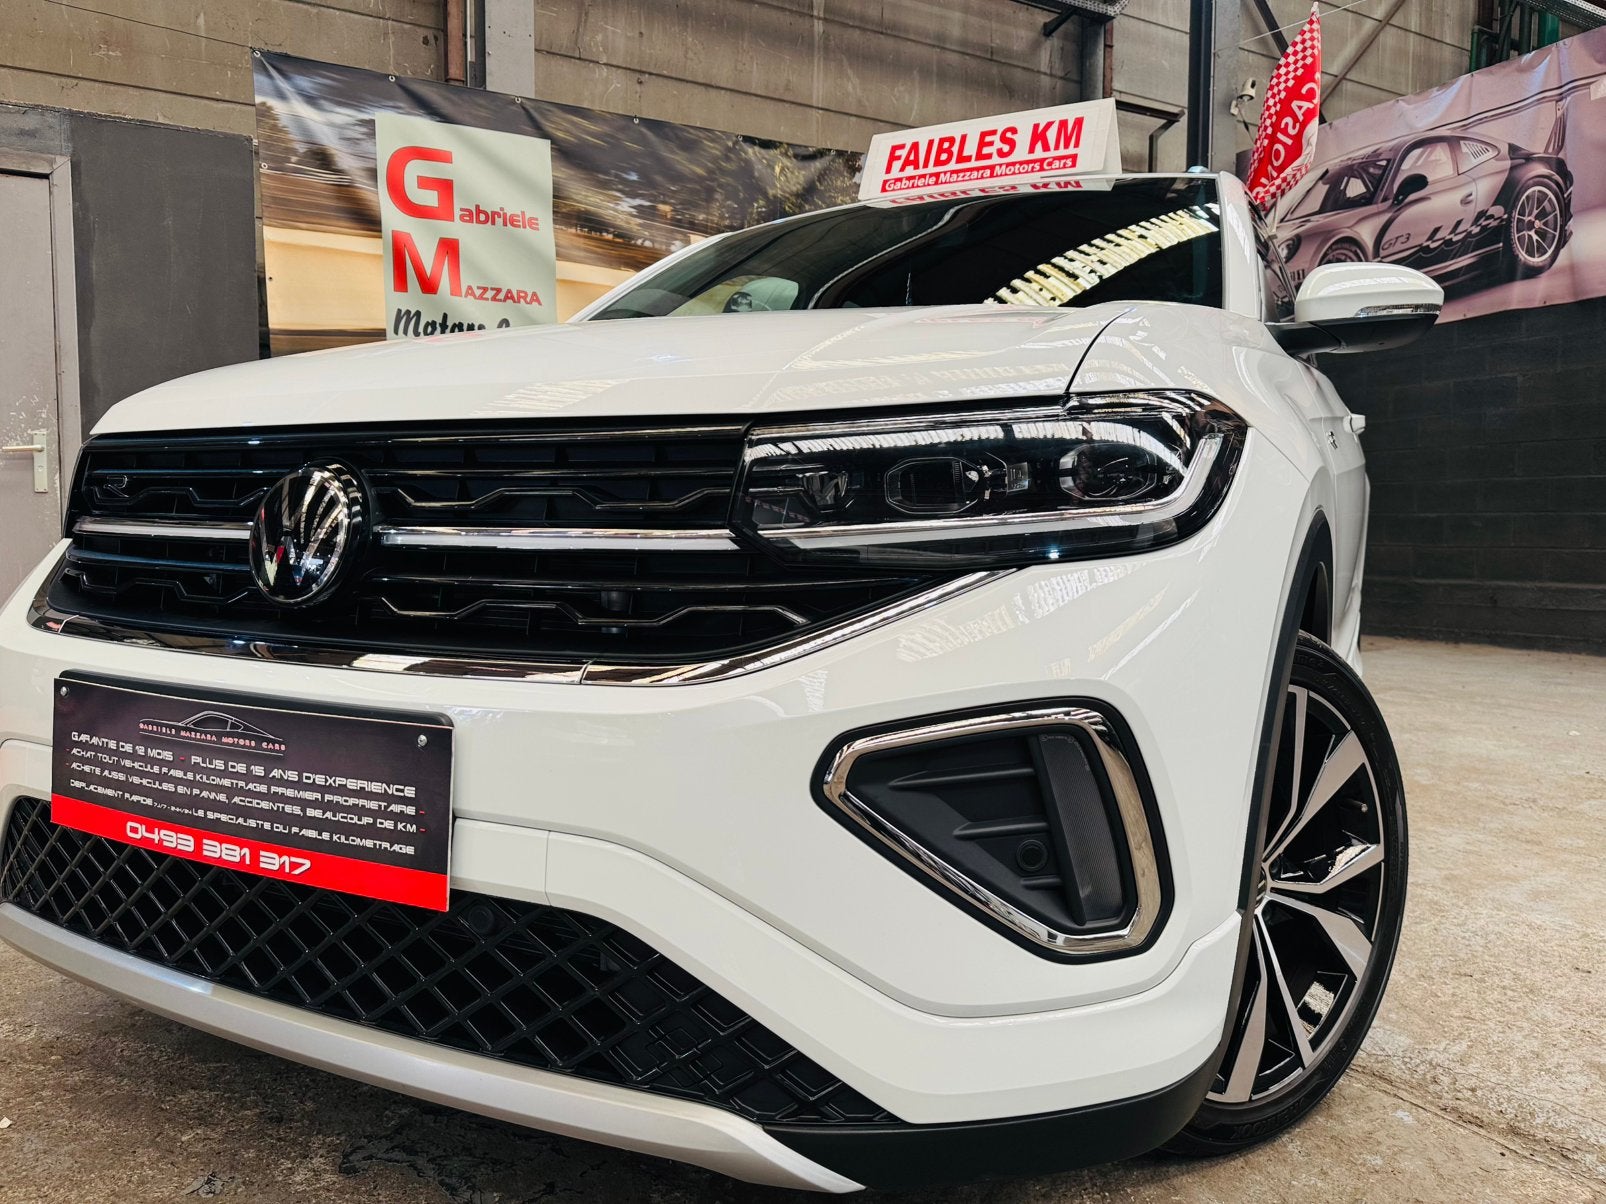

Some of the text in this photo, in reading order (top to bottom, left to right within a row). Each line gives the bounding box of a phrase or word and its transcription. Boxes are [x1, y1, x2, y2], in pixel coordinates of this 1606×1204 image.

[885, 116, 1085, 174] FAIBLES KM
[885, 157, 1073, 191] Gabriele Mazzara Motors Cars
[1381, 232, 1412, 251] GT3
[72, 732, 117, 750] GARANTIE
[119, 742, 134, 753] DE
[136, 744, 146, 755] 12
[148, 748, 173, 761] MOIS
[191, 756, 224, 770] PLUS
[228, 762, 246, 774] DE
[250, 766, 264, 776] 15
[269, 768, 298, 781] ANS
[302, 772, 416, 798] D'EXPERIENCE
[180, 730, 217, 741] MAZZARA
[221, 736, 256, 747] MOTORS
[261, 742, 286, 750] CARS
[70, 762, 417, 833] ACHETE AUSSI VEHICULES EN PANNE, ACCIDENTES, BEAUCOUP DE KM
[71, 748, 416, 816] ACHAT TOUT VEHICULE FAIBLE KILOMETRAGE PREMIER PROPRIETAIRE
[70, 779, 122, 799] DEPLACEMENT
[124, 792, 153, 806] RAPIDE
[192, 808, 204, 817] LE
[206, 810, 272, 830] SPECIALISTE
[274, 825, 288, 834] DU
[291, 826, 330, 840] FAIBLE
[332, 834, 415, 855] KILOMETRAGE
[126, 821, 311, 875] 0493 381 317
